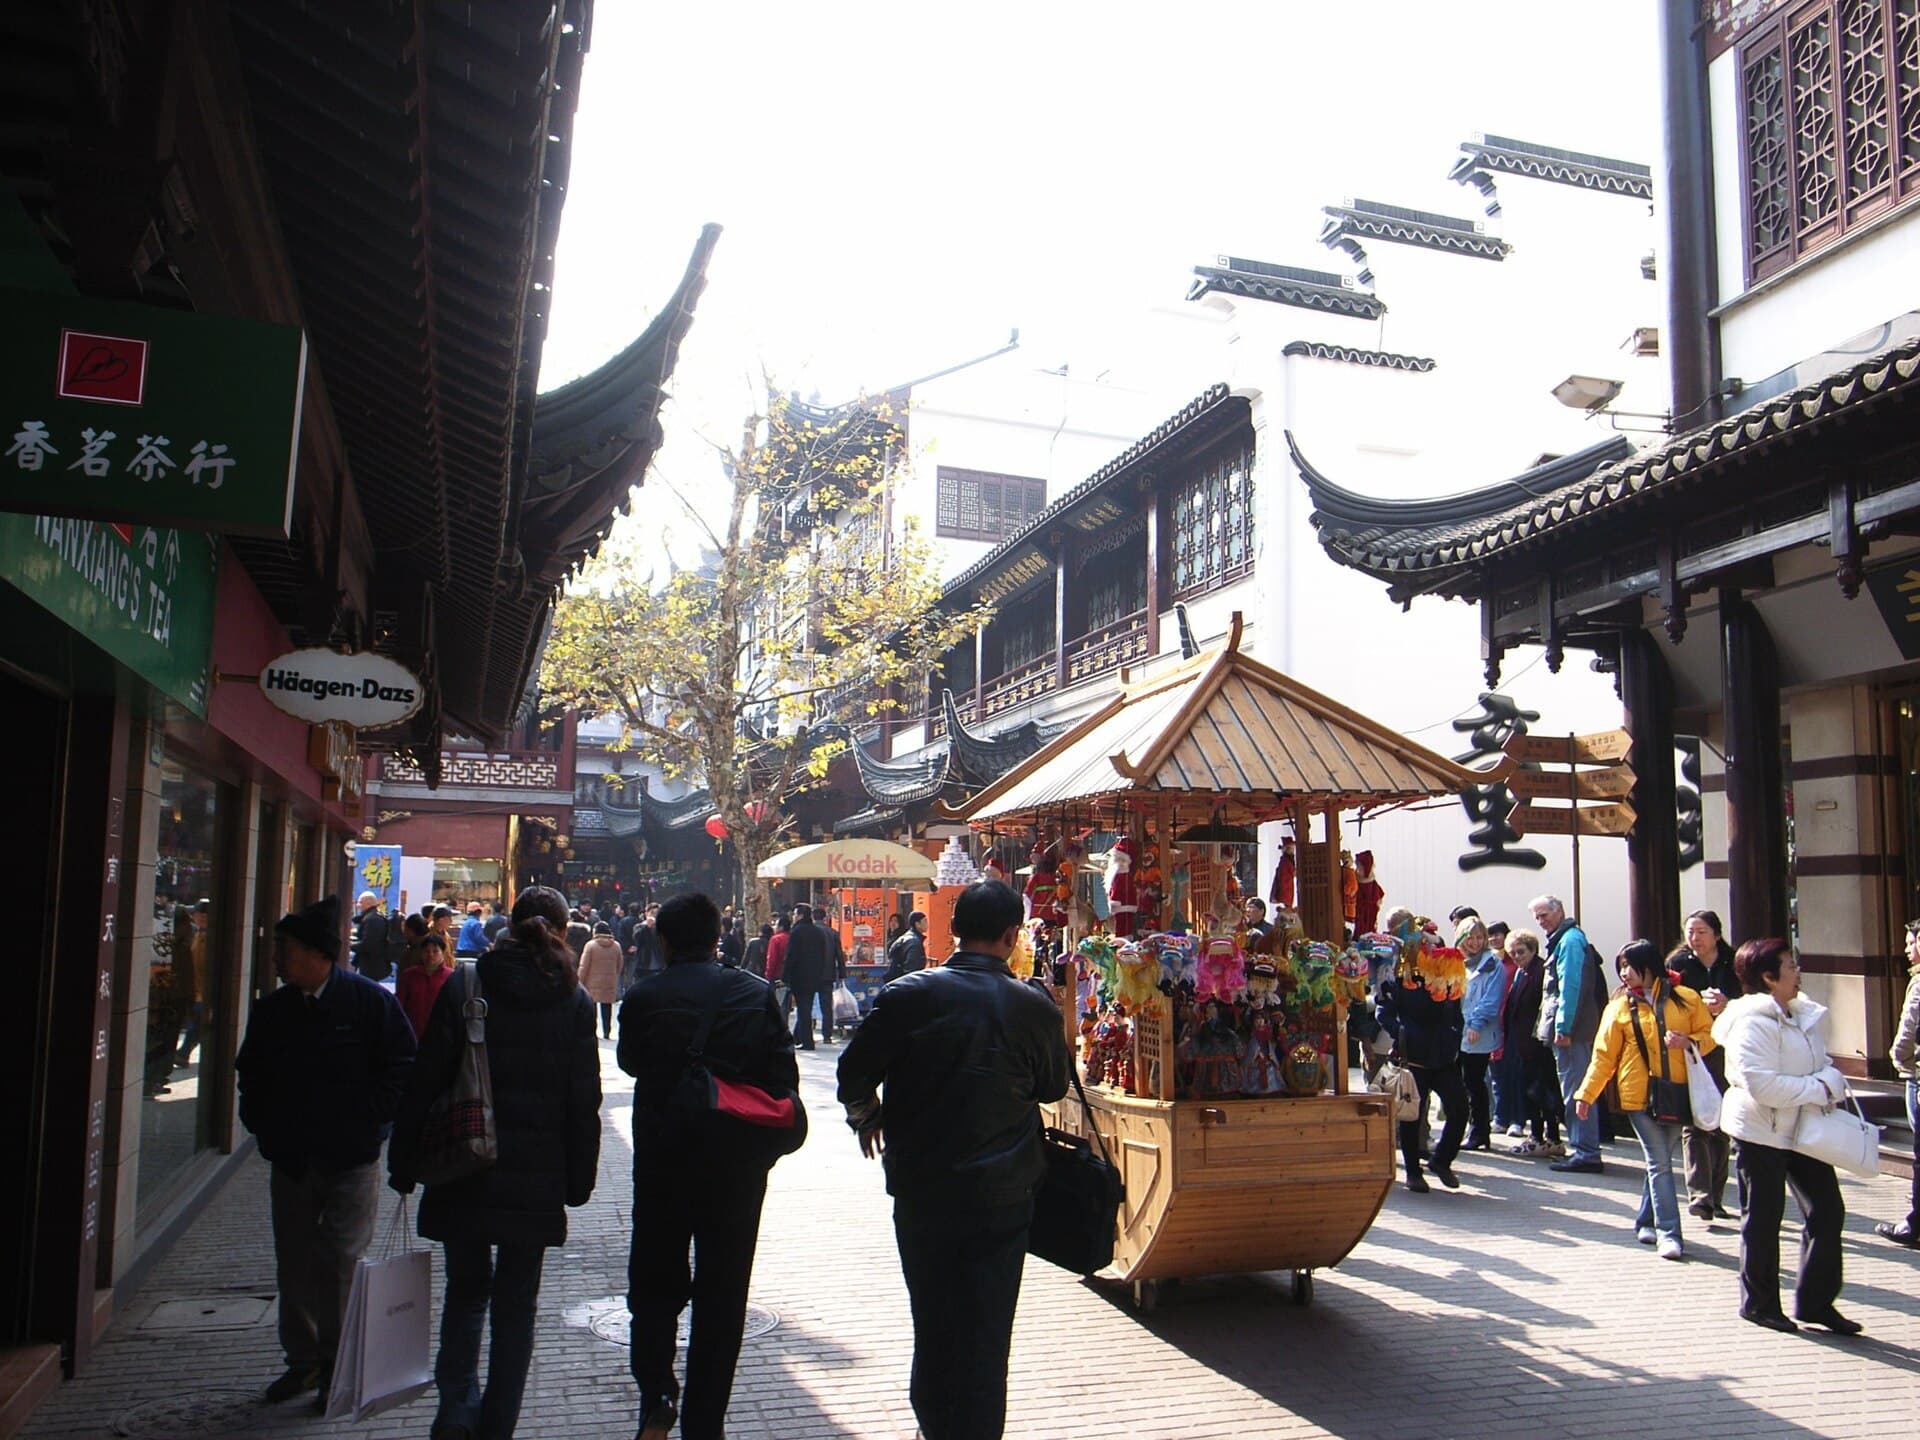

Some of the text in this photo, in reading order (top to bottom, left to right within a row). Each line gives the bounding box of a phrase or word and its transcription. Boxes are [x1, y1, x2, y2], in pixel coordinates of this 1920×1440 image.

[4, 420, 237, 490] 香茗茶行
[145, 580, 172, 649] TEA
[266, 668, 415, 704] Häagen-Dazs
[827, 852, 898, 875] Kodak
